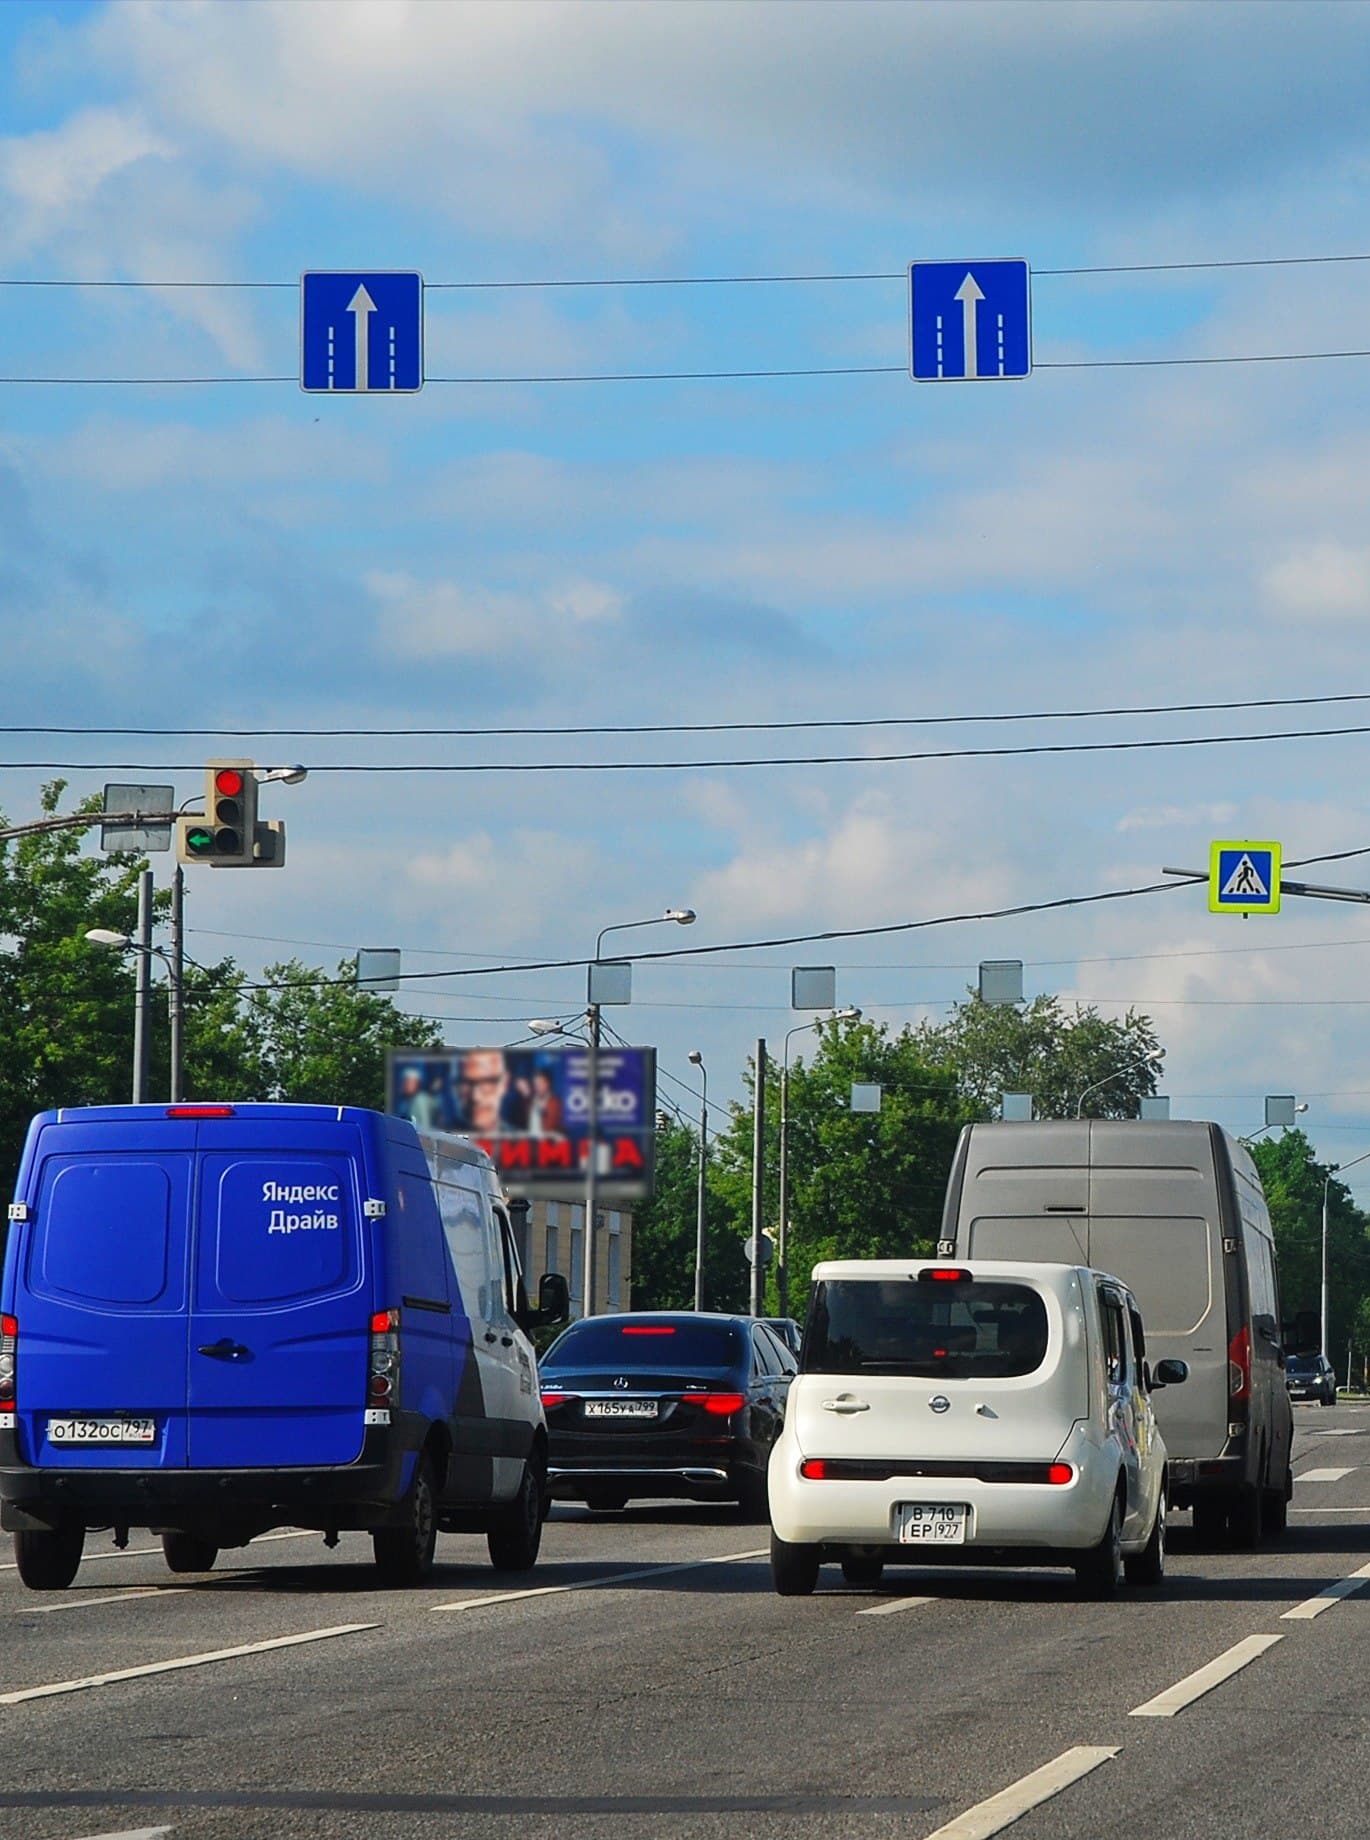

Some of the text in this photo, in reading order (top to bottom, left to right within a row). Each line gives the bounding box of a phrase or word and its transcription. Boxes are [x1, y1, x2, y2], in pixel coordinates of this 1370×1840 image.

[262, 1181, 339, 1204] Яндекс
[268, 1209, 339, 1234] Драйв
[124, 1420, 150, 1434] 797
[928, 1507, 955, 1521] 710
[938, 1524, 959, 1534] 977
